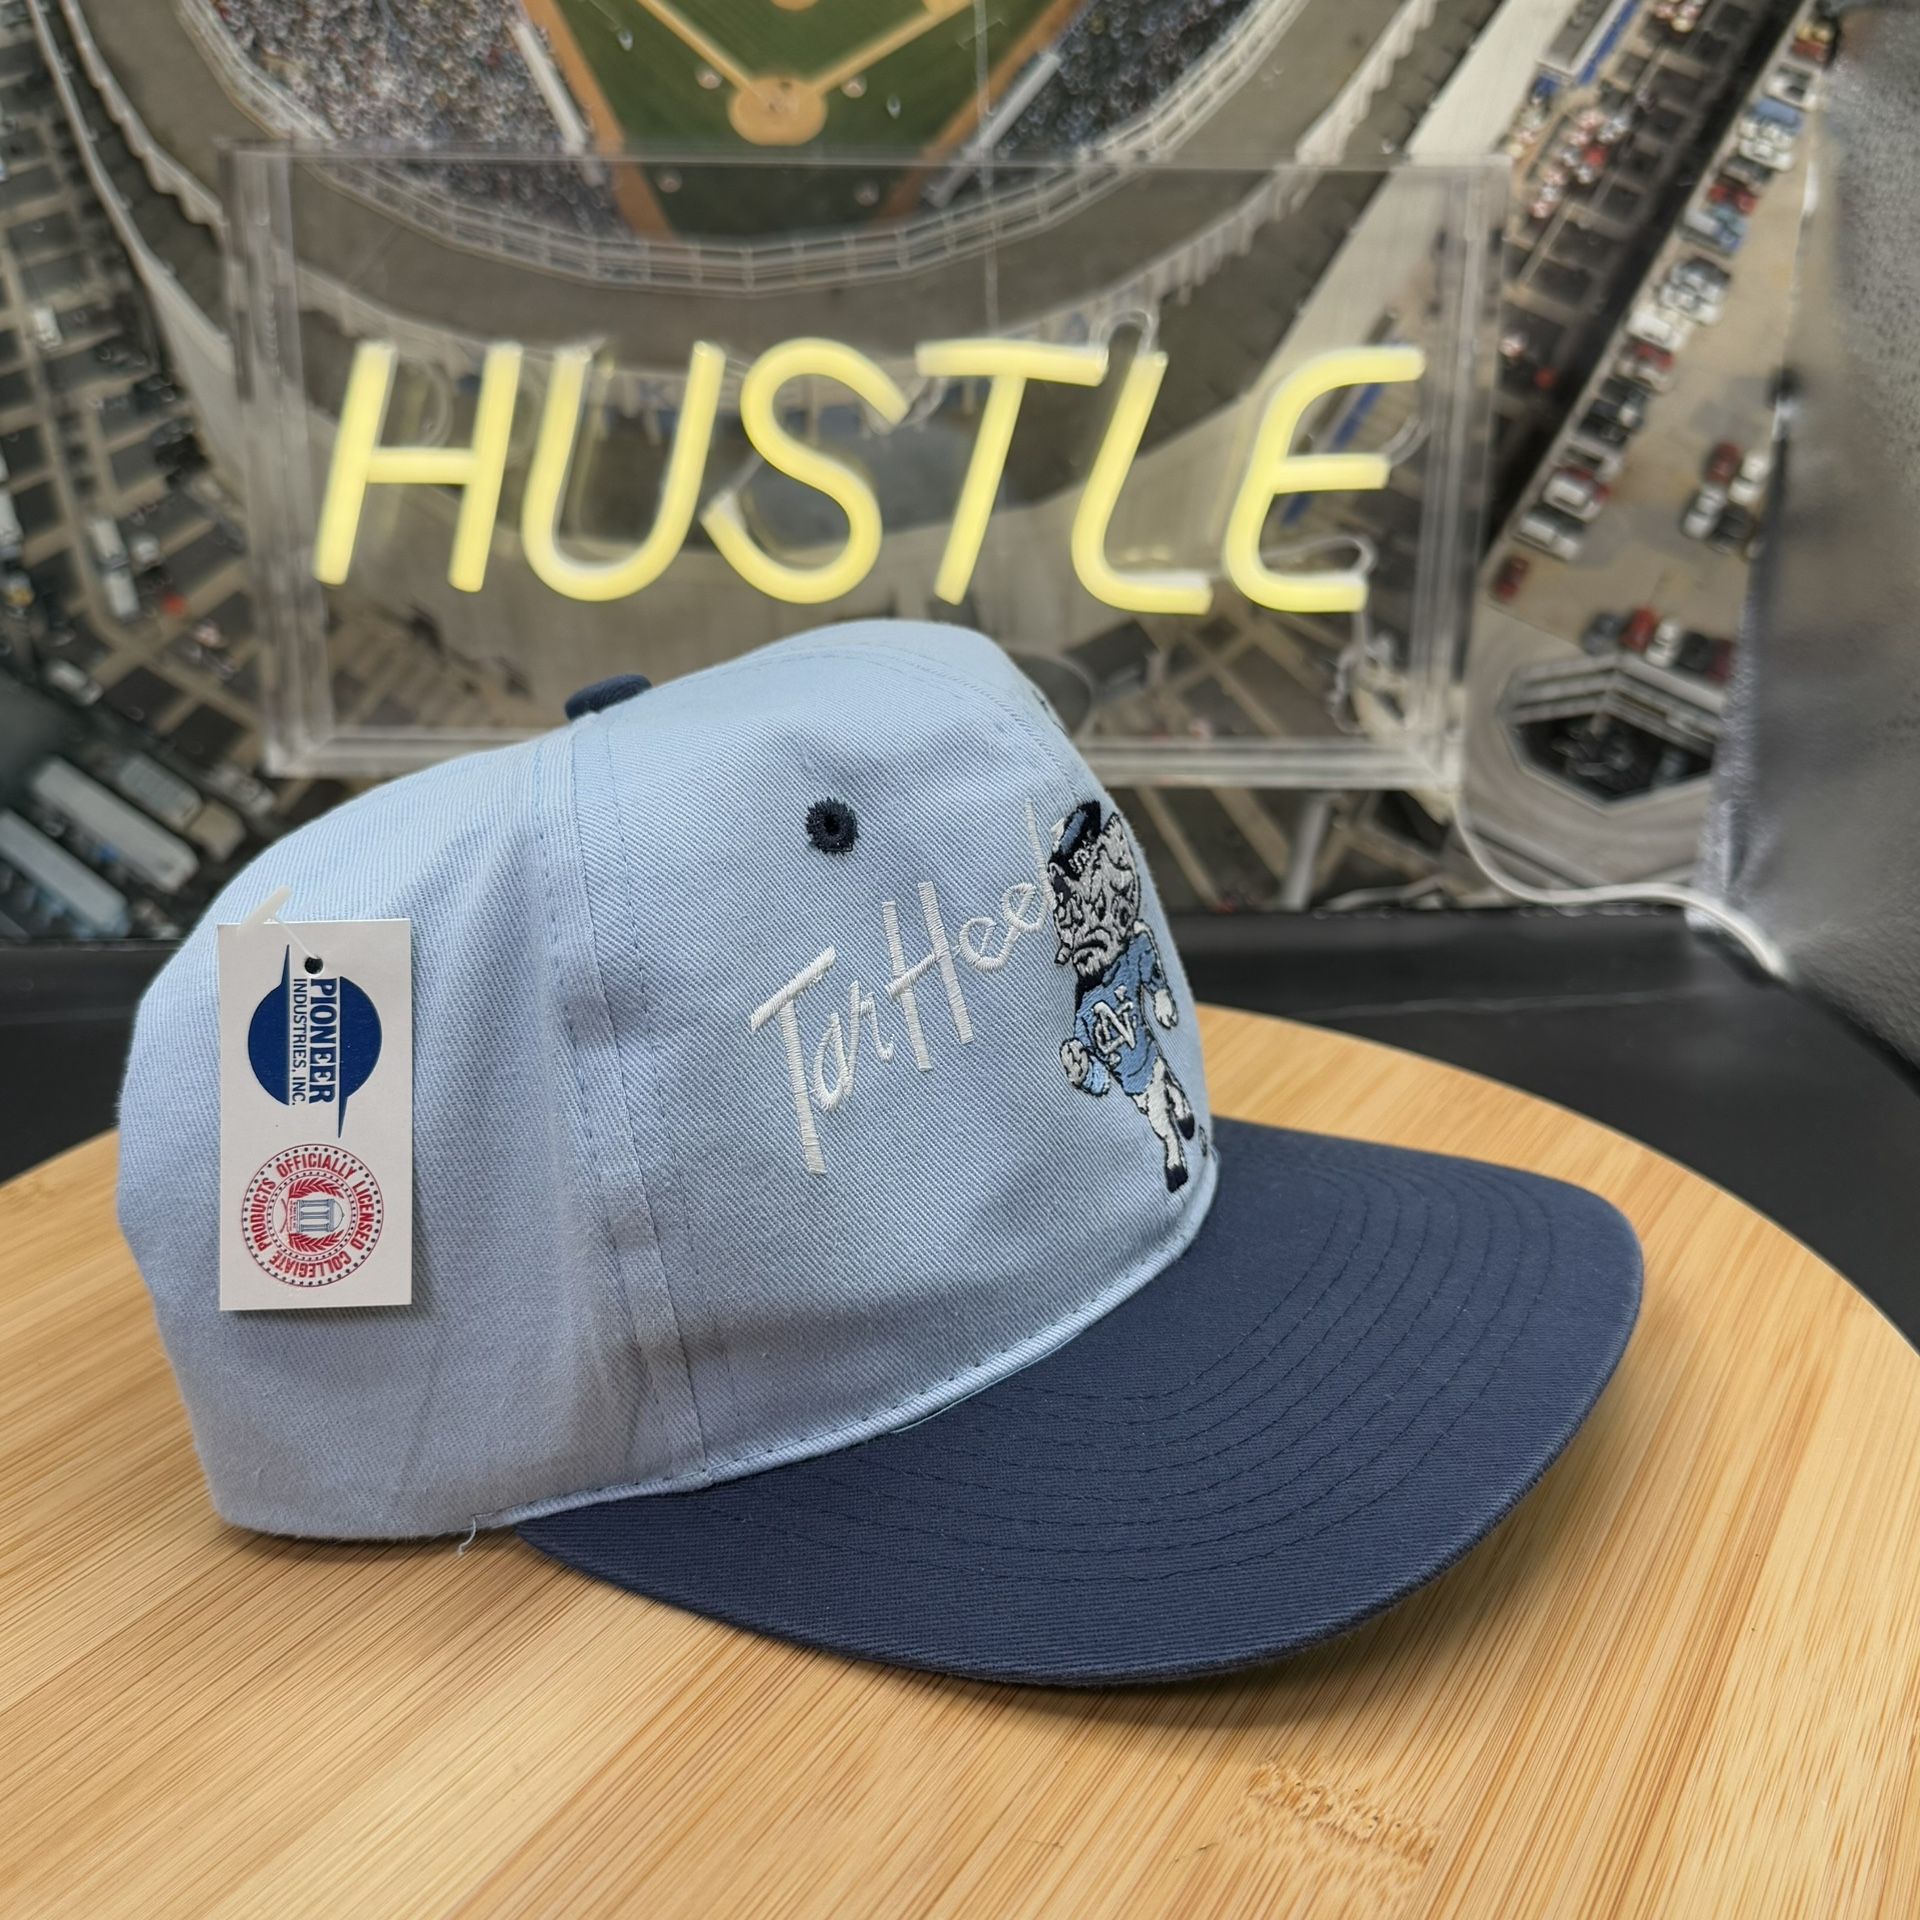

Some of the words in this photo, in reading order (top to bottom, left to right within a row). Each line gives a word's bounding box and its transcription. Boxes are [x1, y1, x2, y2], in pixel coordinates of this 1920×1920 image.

[313, 337, 1426, 615] HUSTLE
[292, 977, 308, 1073] INDUSTRIES,
[308, 977, 338, 1104] PIONEER
[291, 1076, 307, 1106] INC.
[276, 1152, 358, 1180] OFFICIALLY
[250, 1177, 277, 1252] PRODUCTS
[351, 1179, 375, 1251] LICENSED
[268, 1250, 353, 1278] COLLEGIATE
